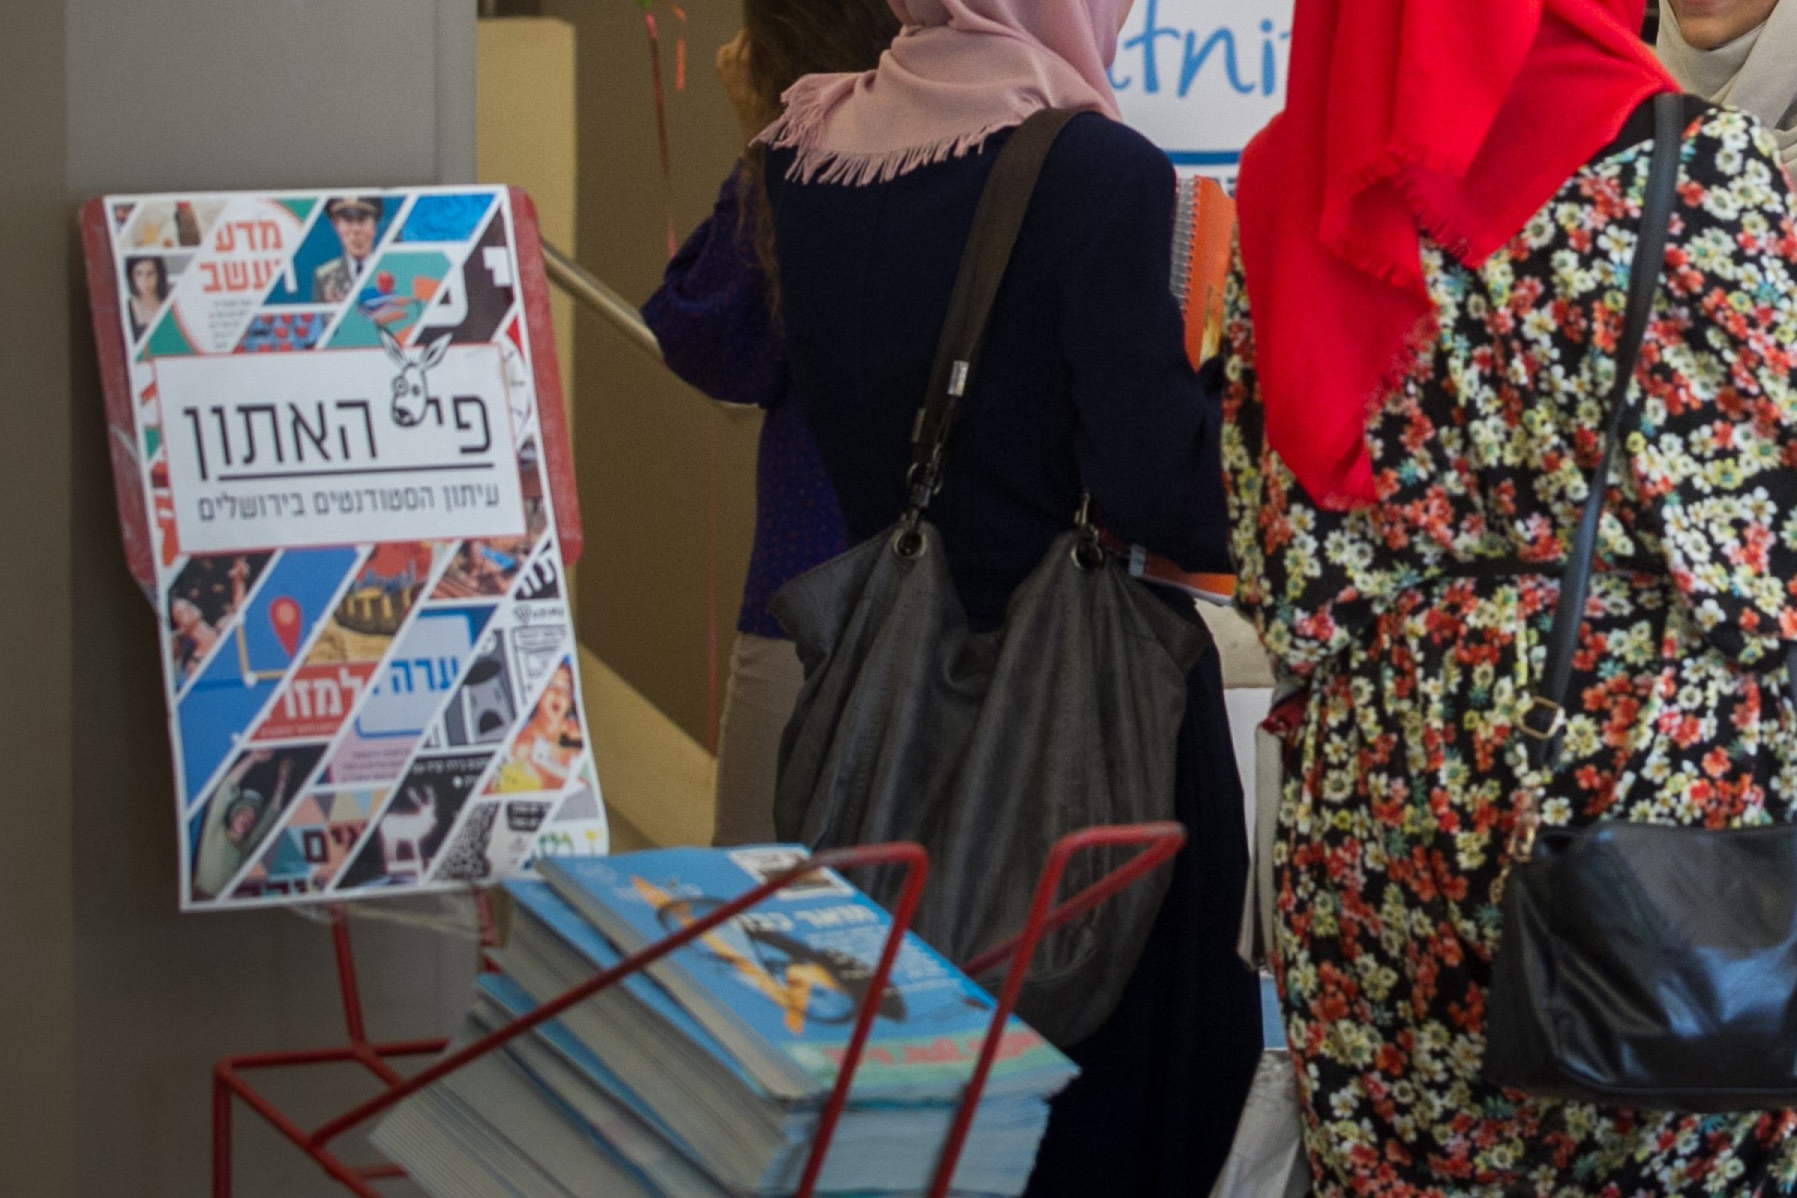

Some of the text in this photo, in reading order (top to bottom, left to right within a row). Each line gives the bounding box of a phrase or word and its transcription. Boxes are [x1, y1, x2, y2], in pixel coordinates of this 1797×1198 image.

[215, 220, 282, 252] מדע
[184, 399, 379, 482] האתון
[199, 484, 500, 521] עיתון הסטודנטים בירושלים
